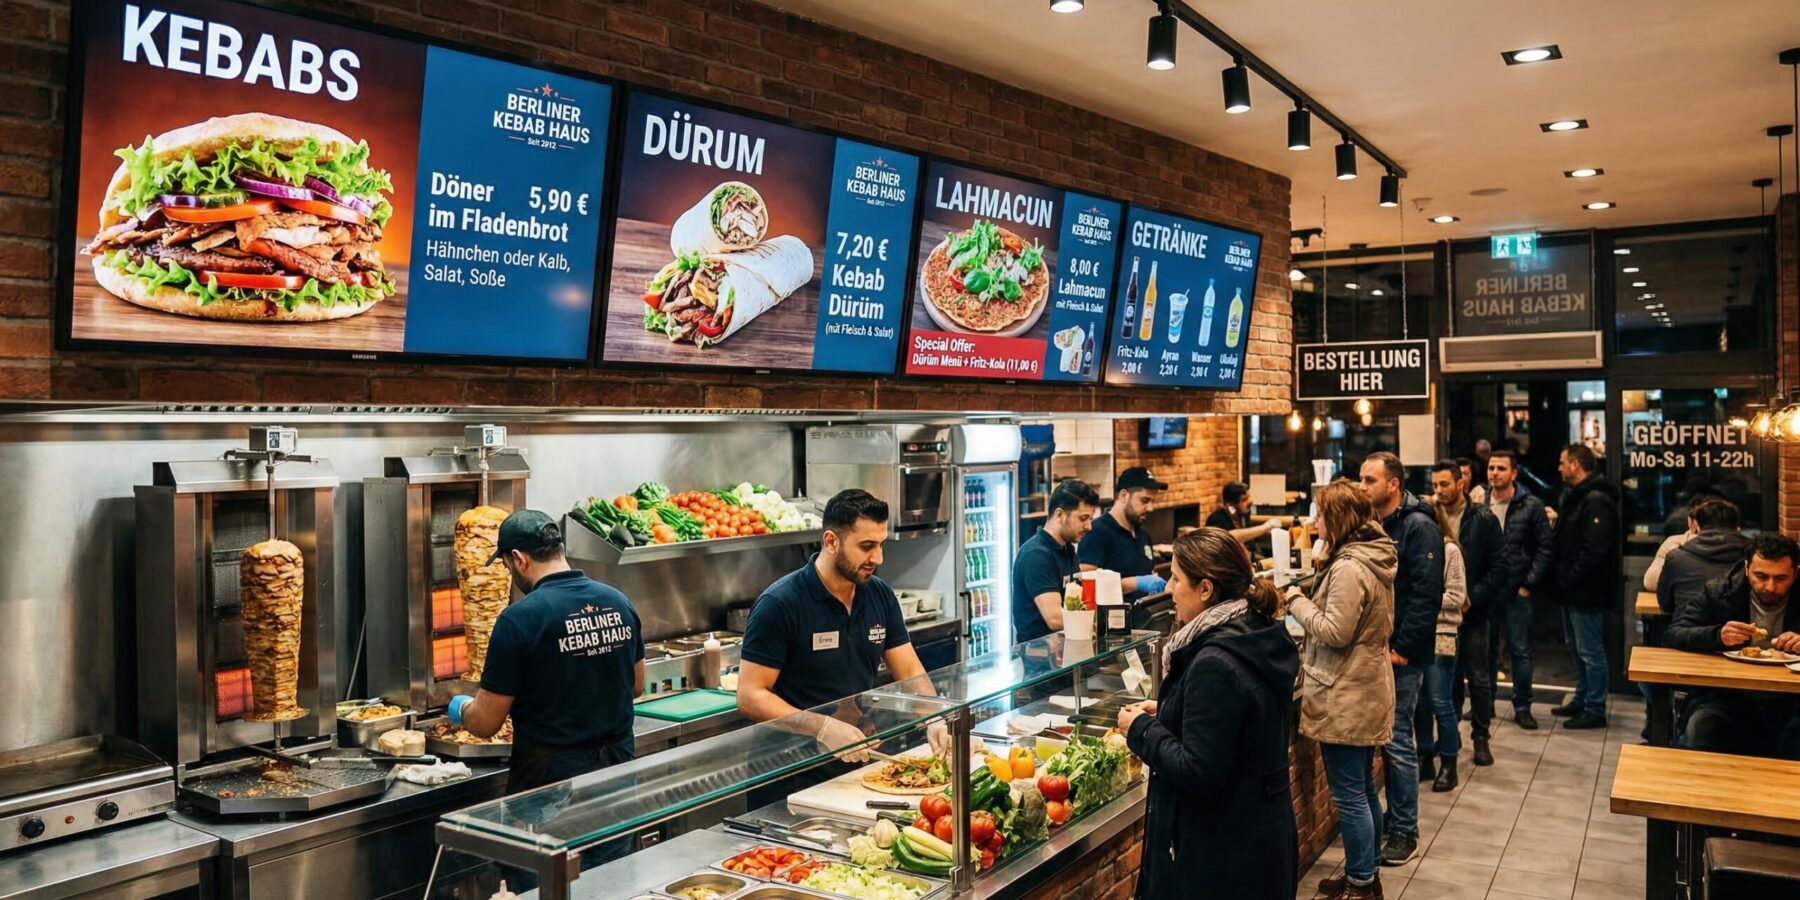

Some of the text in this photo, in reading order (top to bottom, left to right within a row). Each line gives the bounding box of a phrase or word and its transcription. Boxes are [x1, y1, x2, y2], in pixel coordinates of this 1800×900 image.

[122, 4, 361, 102] KEBABS
[507, 93, 581, 123] BERLINER
[493, 110, 590, 144] KEBAB HAUS
[643, 111, 766, 175] DÜRUM
[855, 166, 900, 187] BERLINER
[431, 171, 589, 215] Döner 5,90 €
[846, 179, 878, 197] KEBAB
[880, 185, 906, 202] HAUS
[935, 177, 1053, 228] LAHMACUN
[428, 203, 568, 243] im Fladenbrot
[837, 231, 889, 261] 7,20 €
[1131, 220, 1208, 259] GETRÄNKE
[426, 239, 571, 272] Hähnchen oder Kalb,
[1070, 258, 1100, 277] 8,00 €
[424, 264, 506, 287] Salat, Soße
[832, 264, 885, 291] Kebab
[1058, 278, 1106, 299] Lahmacun
[828, 293, 884, 320] Dürüm
[914, 336, 975, 353] Special Offer:
[912, 353, 939, 366] Dürüm
[940, 353, 962, 367] Menü
[963, 359, 969, 367] +
[970, 356, 1005, 370] Fritz-Kola
[1006, 358, 1029, 373] (11,00
[1304, 348, 1420, 371] BESTELLUNG
[1340, 372, 1383, 391] HIER
[1633, 420, 1748, 445] GEÖFFNET
[1630, 451, 1754, 468] Mo-Sa 11-22h
[565, 612, 623, 634] BERLINER
[558, 626, 632, 653] KEBAB HAUS
